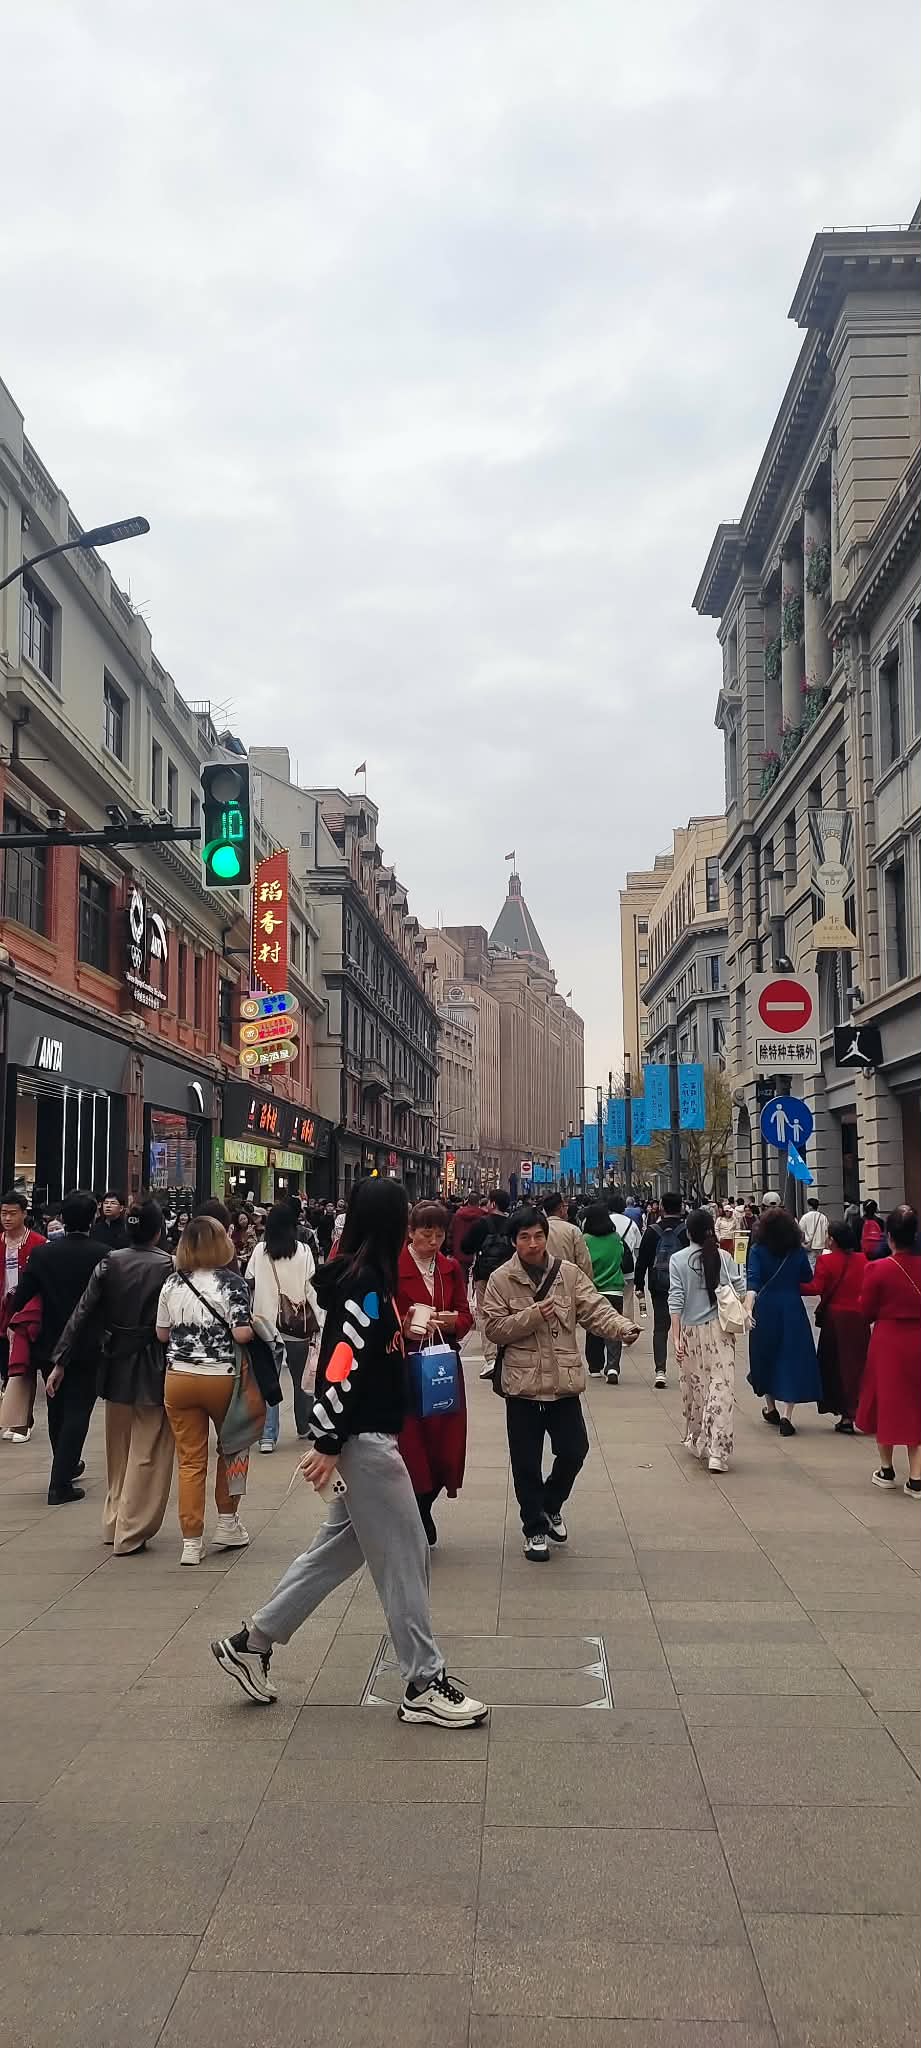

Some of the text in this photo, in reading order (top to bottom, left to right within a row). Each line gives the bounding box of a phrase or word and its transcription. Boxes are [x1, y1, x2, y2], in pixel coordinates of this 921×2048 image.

[258, 880, 283, 963] 稻香村
[39, 1036, 63, 1073] ANTA
[759, 1043, 815, 1061] 除特种车辆外
